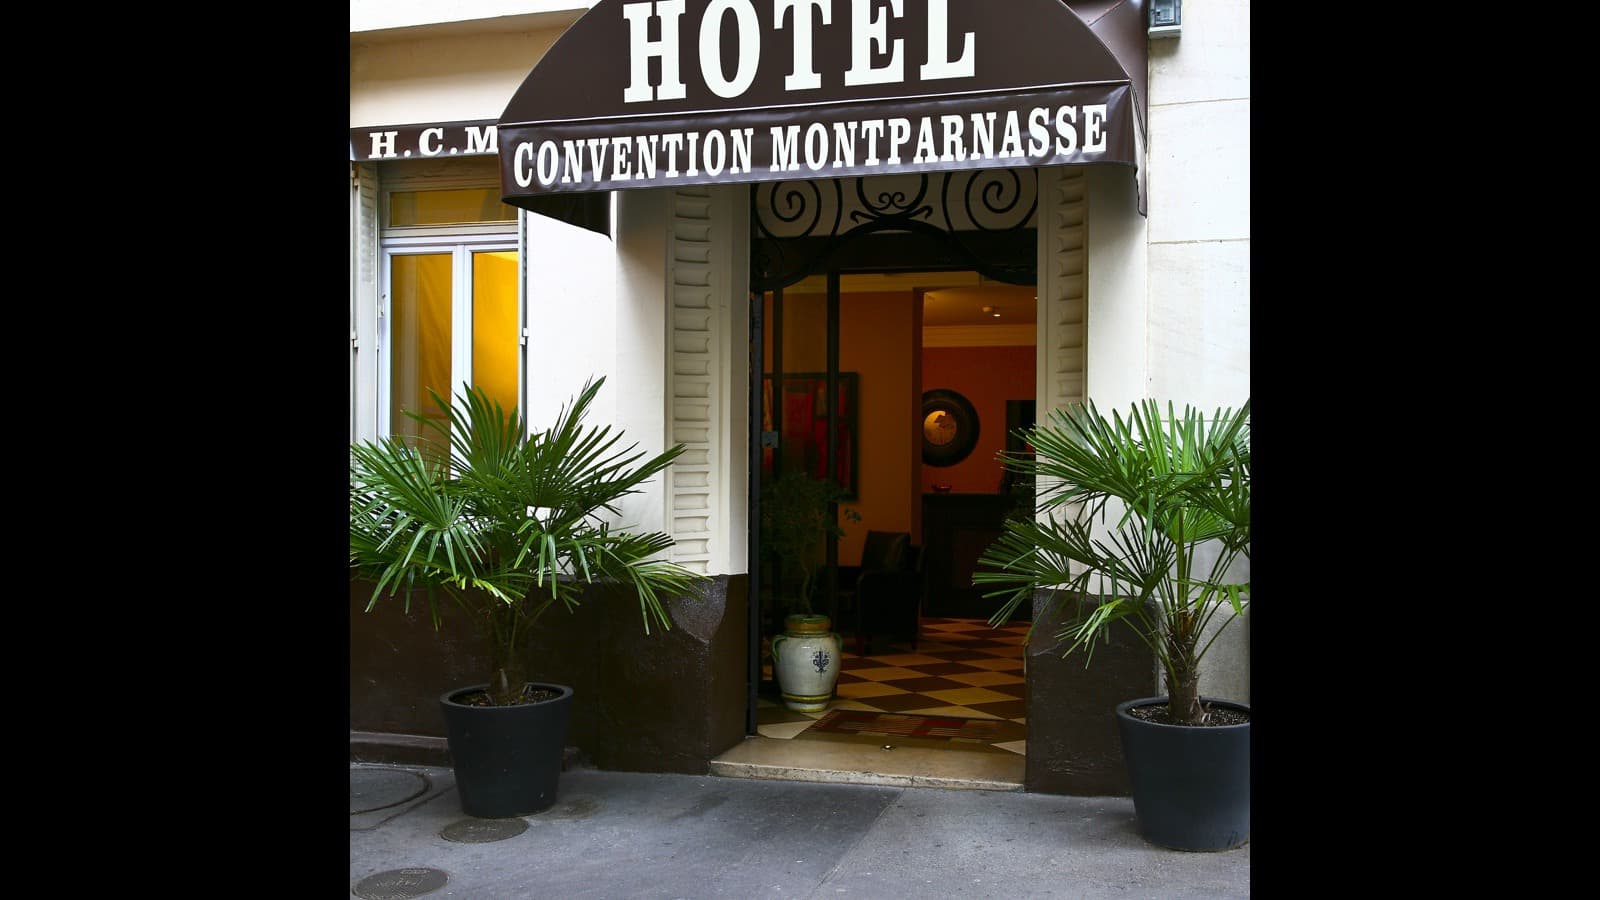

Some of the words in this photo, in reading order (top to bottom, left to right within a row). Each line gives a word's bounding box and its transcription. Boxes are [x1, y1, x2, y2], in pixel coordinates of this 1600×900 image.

[622, 0, 976, 103] HOTEL
[513, 127, 755, 189] CONVENTION
[768, 103, 1109, 173] MONTPARNASSE
